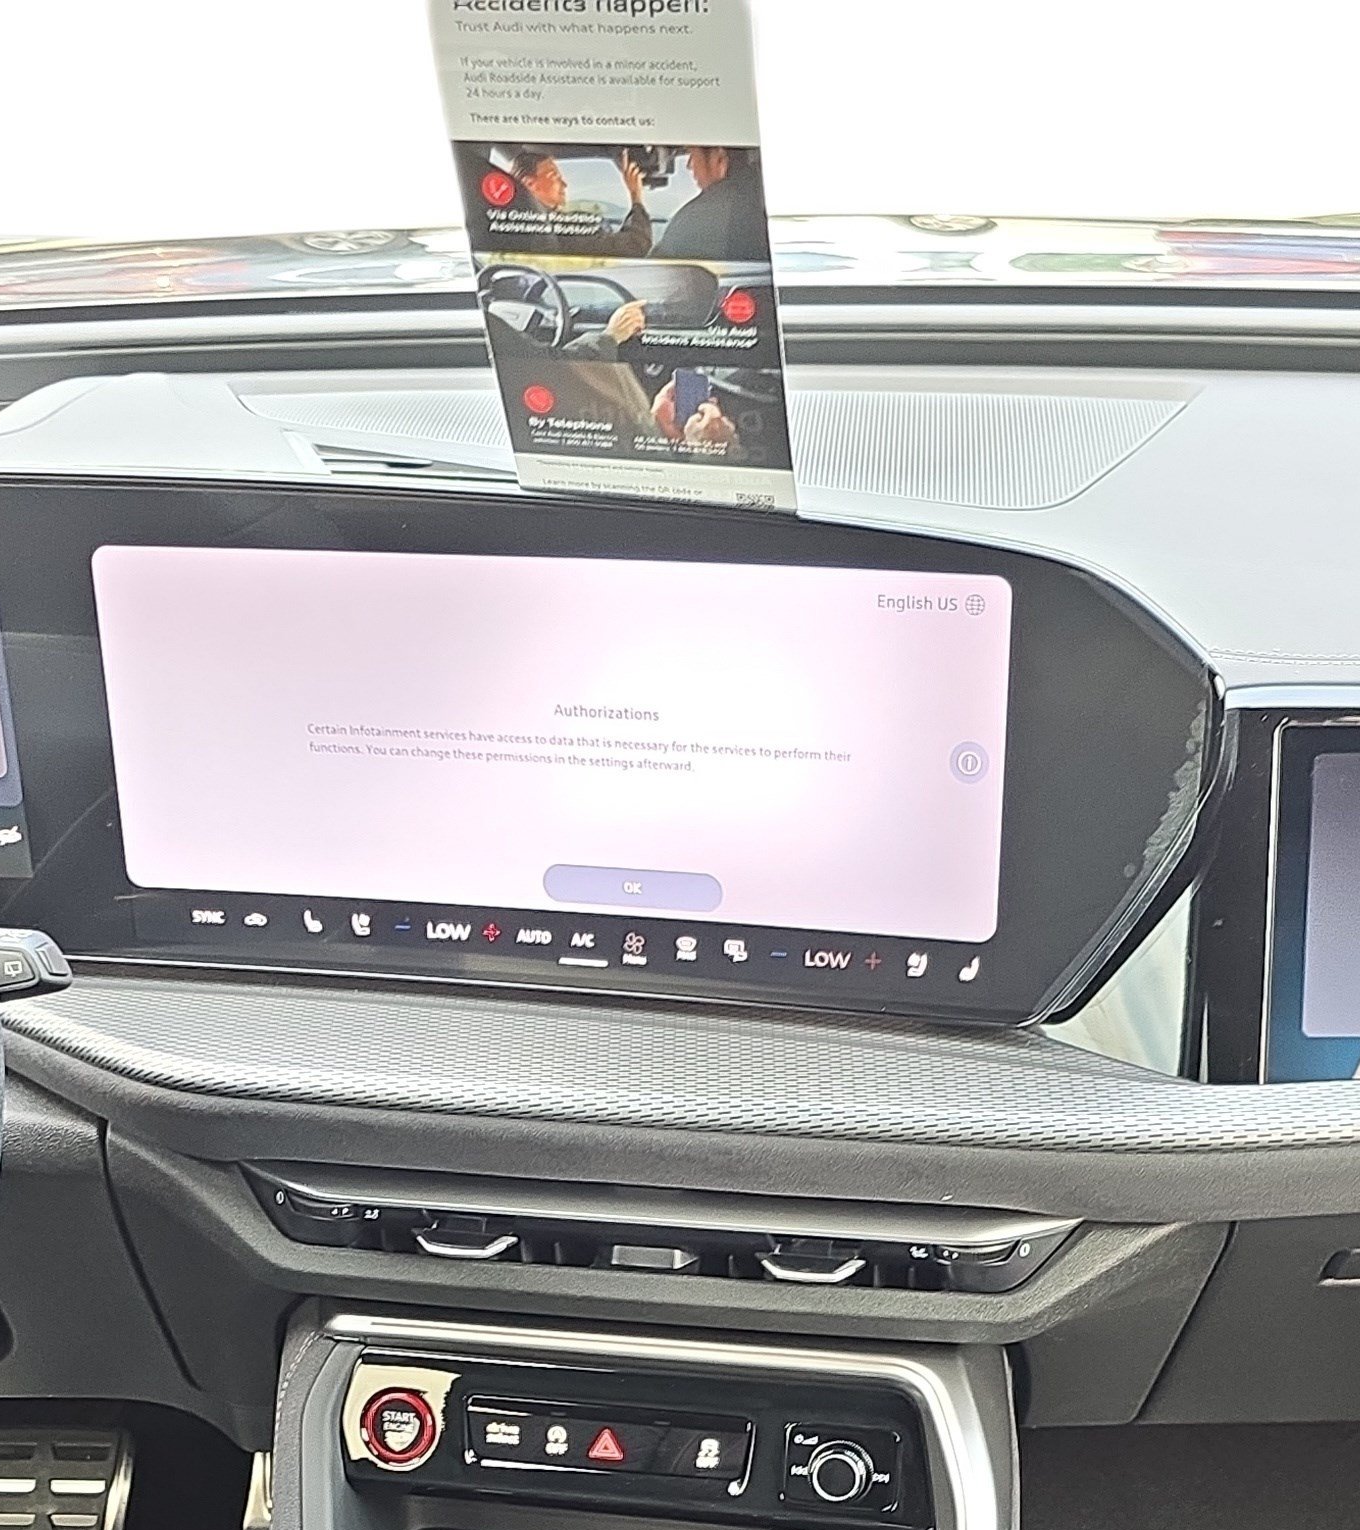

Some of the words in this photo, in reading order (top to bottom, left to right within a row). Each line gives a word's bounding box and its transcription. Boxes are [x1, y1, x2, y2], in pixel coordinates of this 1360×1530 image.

[455, 21, 490, 32] Trust
[493, 22, 524, 32] Audi
[526, 22, 557, 33] with
[560, 23, 594, 33] what
[598, 23, 656, 35] happens
[660, 24, 694, 34] next.
[460, 57, 468, 67] If
[469, 59, 494, 70] your
[496, 58, 533, 68] vehicle
[536, 58, 545, 68] is
[547, 58, 591, 69] involved
[593, 60, 603, 69] in
[615, 60, 646, 70] minor
[649, 60, 698, 72] accident,
[463, 73, 488, 83] Audi
[490, 73, 537, 84] Roadside
[540, 74, 595, 85] Assistance
[597, 75, 607, 85] is
[609, 74, 656, 86] available
[658, 76, 676, 86] for
[677, 77, 721, 88] support
[466, 88, 480, 98] 24
[482, 88, 513, 99] hours
[515, 91, 522, 99] a
[523, 89, 545, 101] day.
[470, 113, 501, 124] There
[502, 115, 520, 124] are
[521, 114, 550, 125] three
[551, 117, 579, 127] ways
[581, 115, 594, 126] to
[596, 116, 637, 127] contact
[638, 117, 656, 127] us:
[528, 416, 546, 430] By
[546, 417, 614, 432] Telephone
[542, 477, 567, 487] Learn
[568, 479, 591, 488] more
[877, 594, 933, 613] English
[937, 597, 959, 612] US
[553, 703, 660, 723] Authorizations
[306, 722, 347, 737] Certain
[349, 724, 421, 739] Infotainment
[423, 728, 467, 742] services
[468, 729, 495, 743] have
[496, 732, 533, 744] access
[534, 733, 548, 745] to
[548, 734, 575, 747] data
[576, 736, 600, 748] that
[602, 737, 613, 748] is
[614, 739, 669, 755] necessary
[671, 740, 688, 753] for
[690, 741, 710, 754] the
[711, 743, 757, 757] services
[758, 747, 772, 758] to
[773, 746, 823, 763] perform
[825, 748, 852, 763] their
[308, 741, 364, 756] functions.
[366, 744, 387, 756] You
[388, 748, 409, 758] can
[410, 747, 452, 762] change
[453, 748, 484, 761] these
[485, 750, 552, 766] permissions
[554, 754, 566, 765] in
[567, 754, 587, 766] the
[588, 755, 635, 771] settings
[637, 756, 696, 772] afterward.
[623, 881, 643, 896] OK
[191, 909, 227, 926] SYNC
[426, 920, 471, 942] LOW
[516, 928, 553, 946] AUTO
[569, 931, 596, 949] A/C
[804, 948, 852, 970] LOW
[382, 1410, 417, 1422] START
